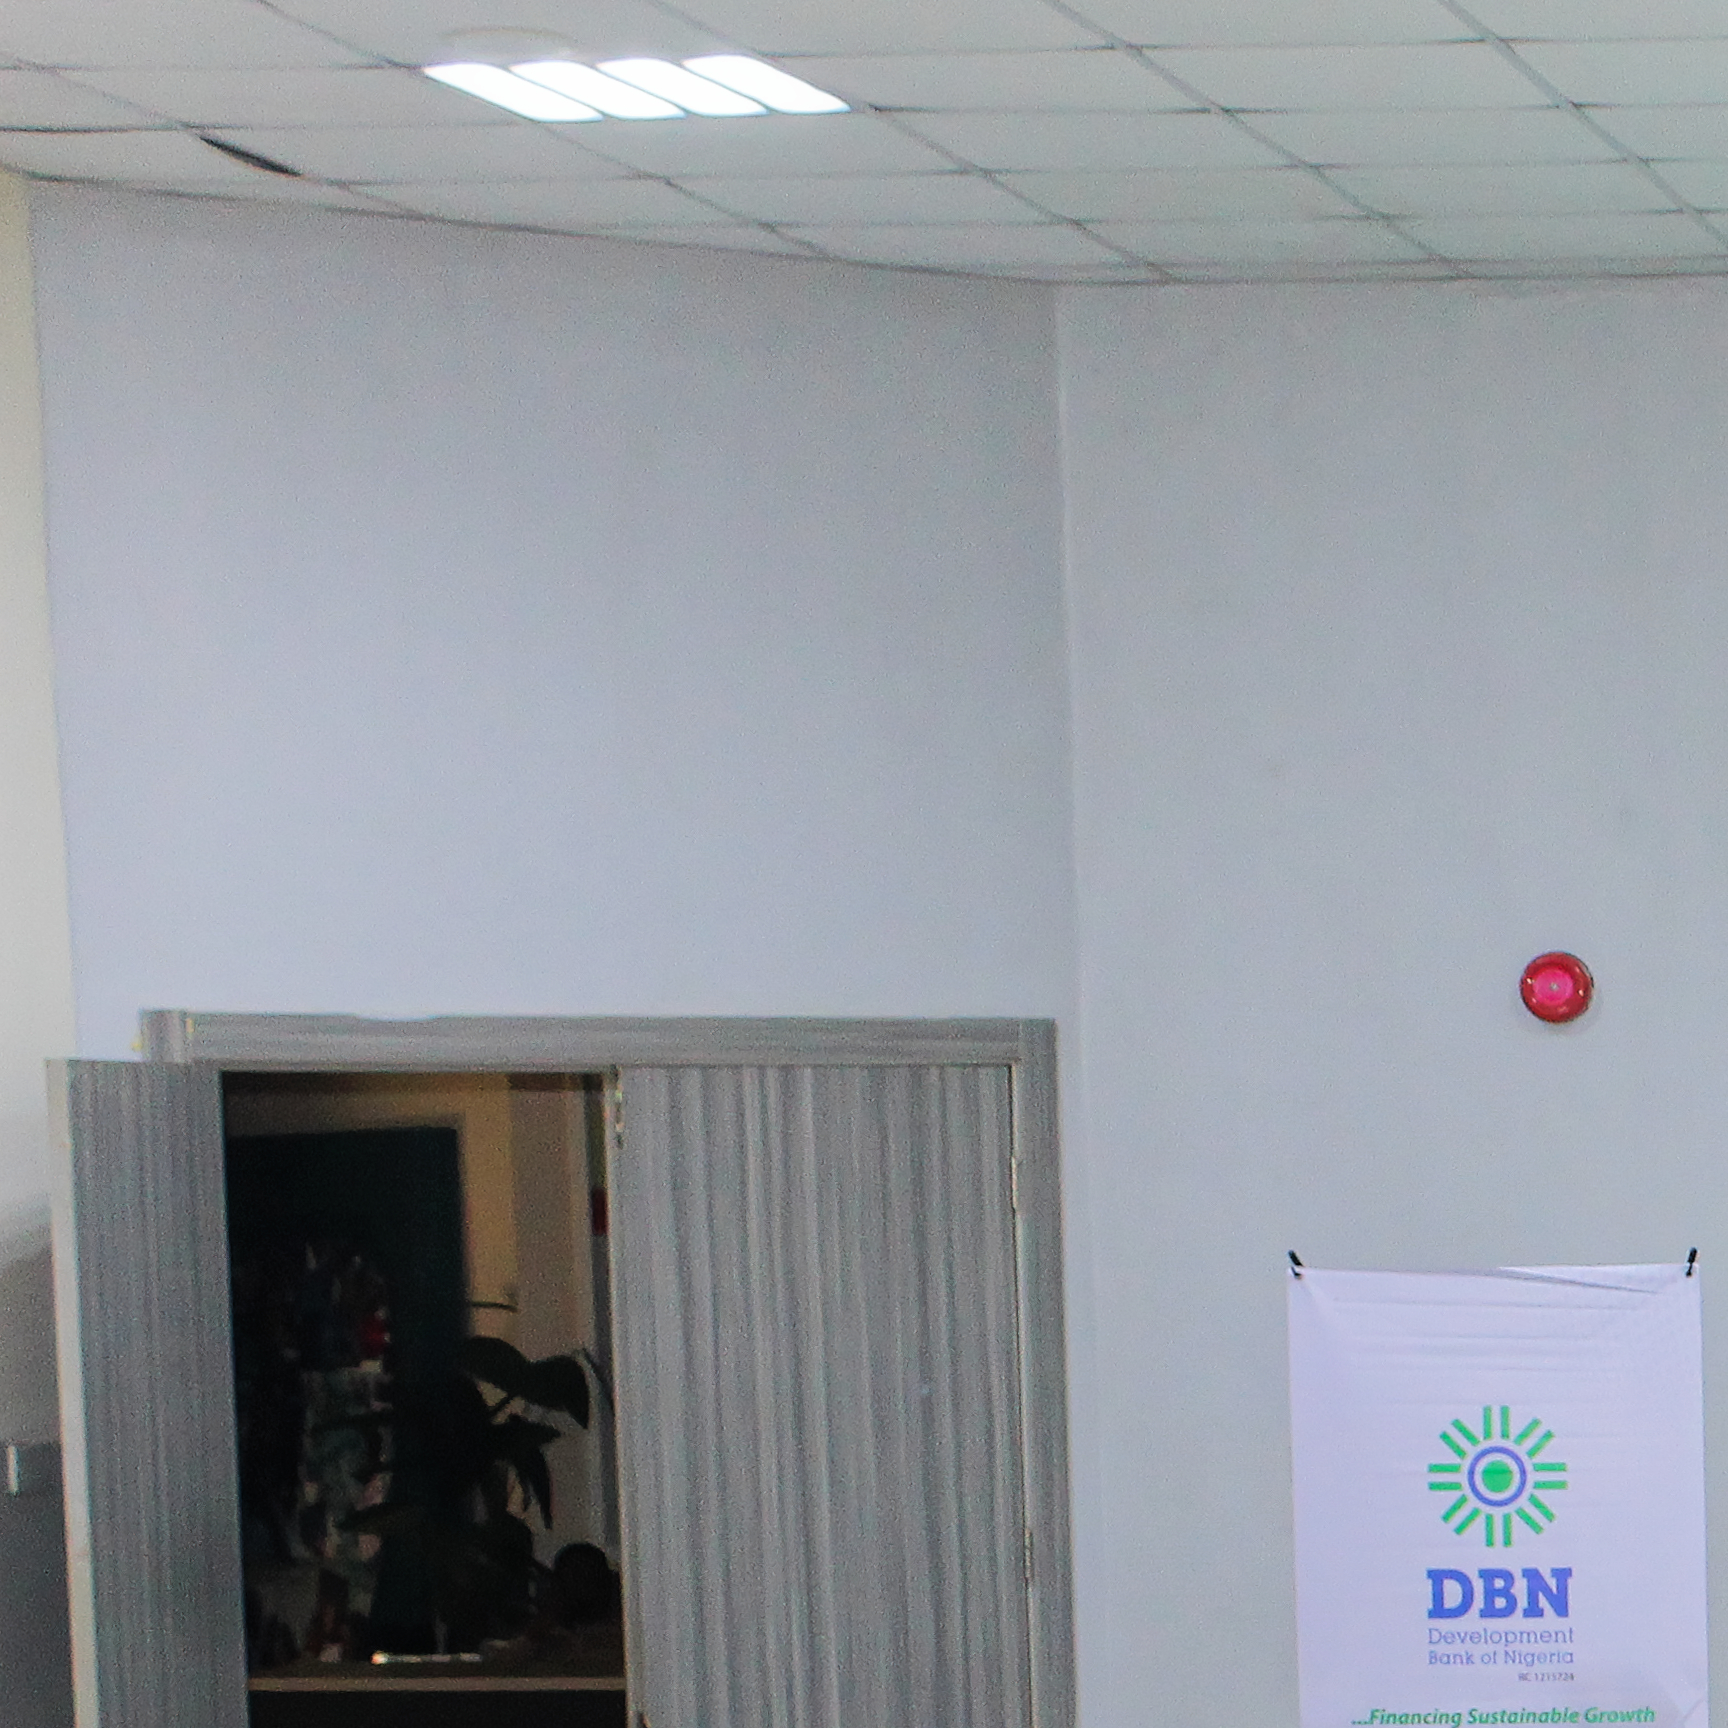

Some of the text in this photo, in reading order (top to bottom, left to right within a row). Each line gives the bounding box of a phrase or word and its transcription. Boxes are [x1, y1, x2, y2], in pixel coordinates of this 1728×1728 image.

[1426, 1567, 1573, 1619] DBN
[1427, 1627, 1574, 1647] Development
[1427, 1649, 1575, 1668] Bank of Nigeria
[1467, 1707, 1579, 1726] Sustainable
[1584, 1705, 1656, 1725] Growth
